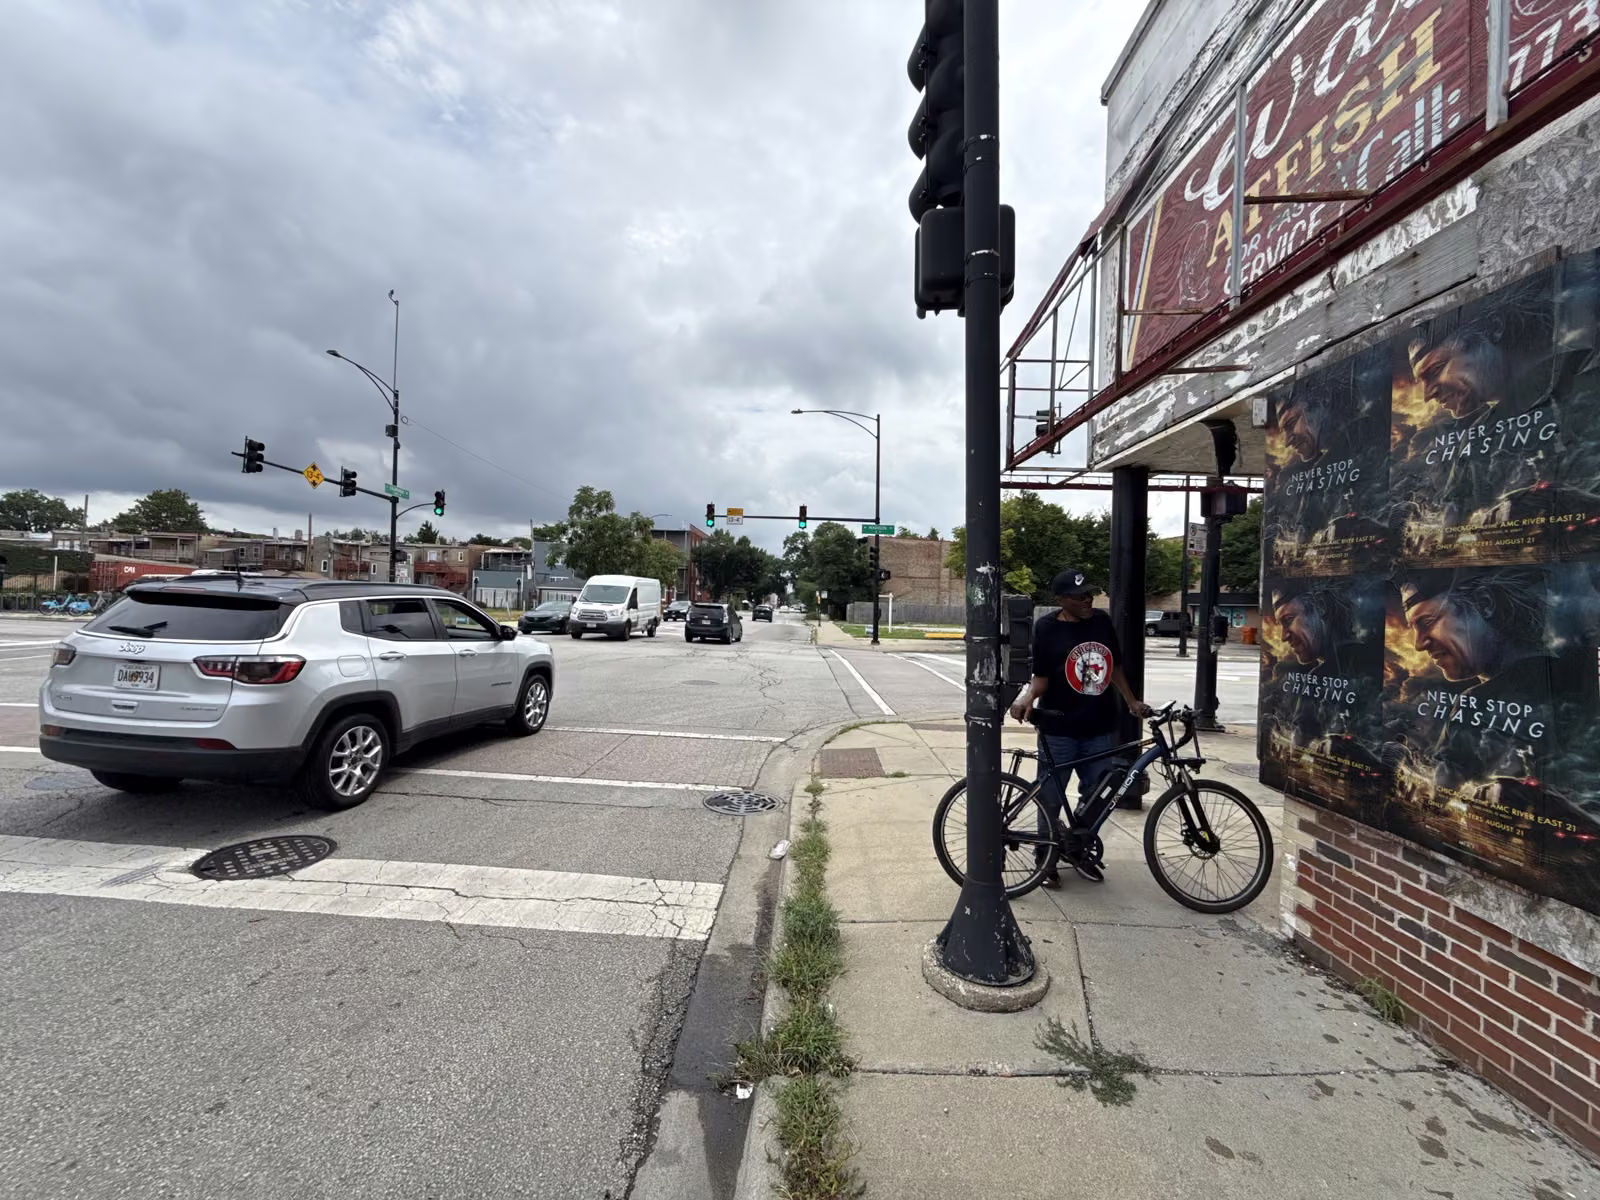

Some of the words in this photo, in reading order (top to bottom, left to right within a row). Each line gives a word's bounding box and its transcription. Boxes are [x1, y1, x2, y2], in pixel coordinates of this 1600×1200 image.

[1435, 425, 1486, 447] NEVER
[1495, 411, 1543, 433] STOP
[1425, 423, 1557, 465] CHASING
[1286, 468, 1360, 496] CHASING
[1291, 467, 1322, 482] NEVER
[1326, 459, 1353, 474] STOP
[1500, 520, 1520, 528] AMC
[1521, 517, 1546, 525] RIVER
[1549, 514, 1573, 523] EAST
[1575, 512, 1585, 521] 21
[1494, 538, 1524, 546] AUGUST
[119, 642, 146, 654] Jeep
[1288, 672, 1318, 685] NEVER
[1322, 676, 1349, 688] STOP
[1282, 681, 1356, 704] CHASING
[1427, 690, 1478, 709] NEVER
[1486, 699, 1533, 717] STOP
[1417, 702, 1545, 738] CHASING
[1485, 819, 1514, 832] AUGUST
[1516, 829, 1524, 837] 21
[1490, 803, 1510, 813] AMC
[1511, 808, 1535, 822] RIVER
[1537, 816, 1563, 828] EAST
[1566, 823, 1577, 833] 21
